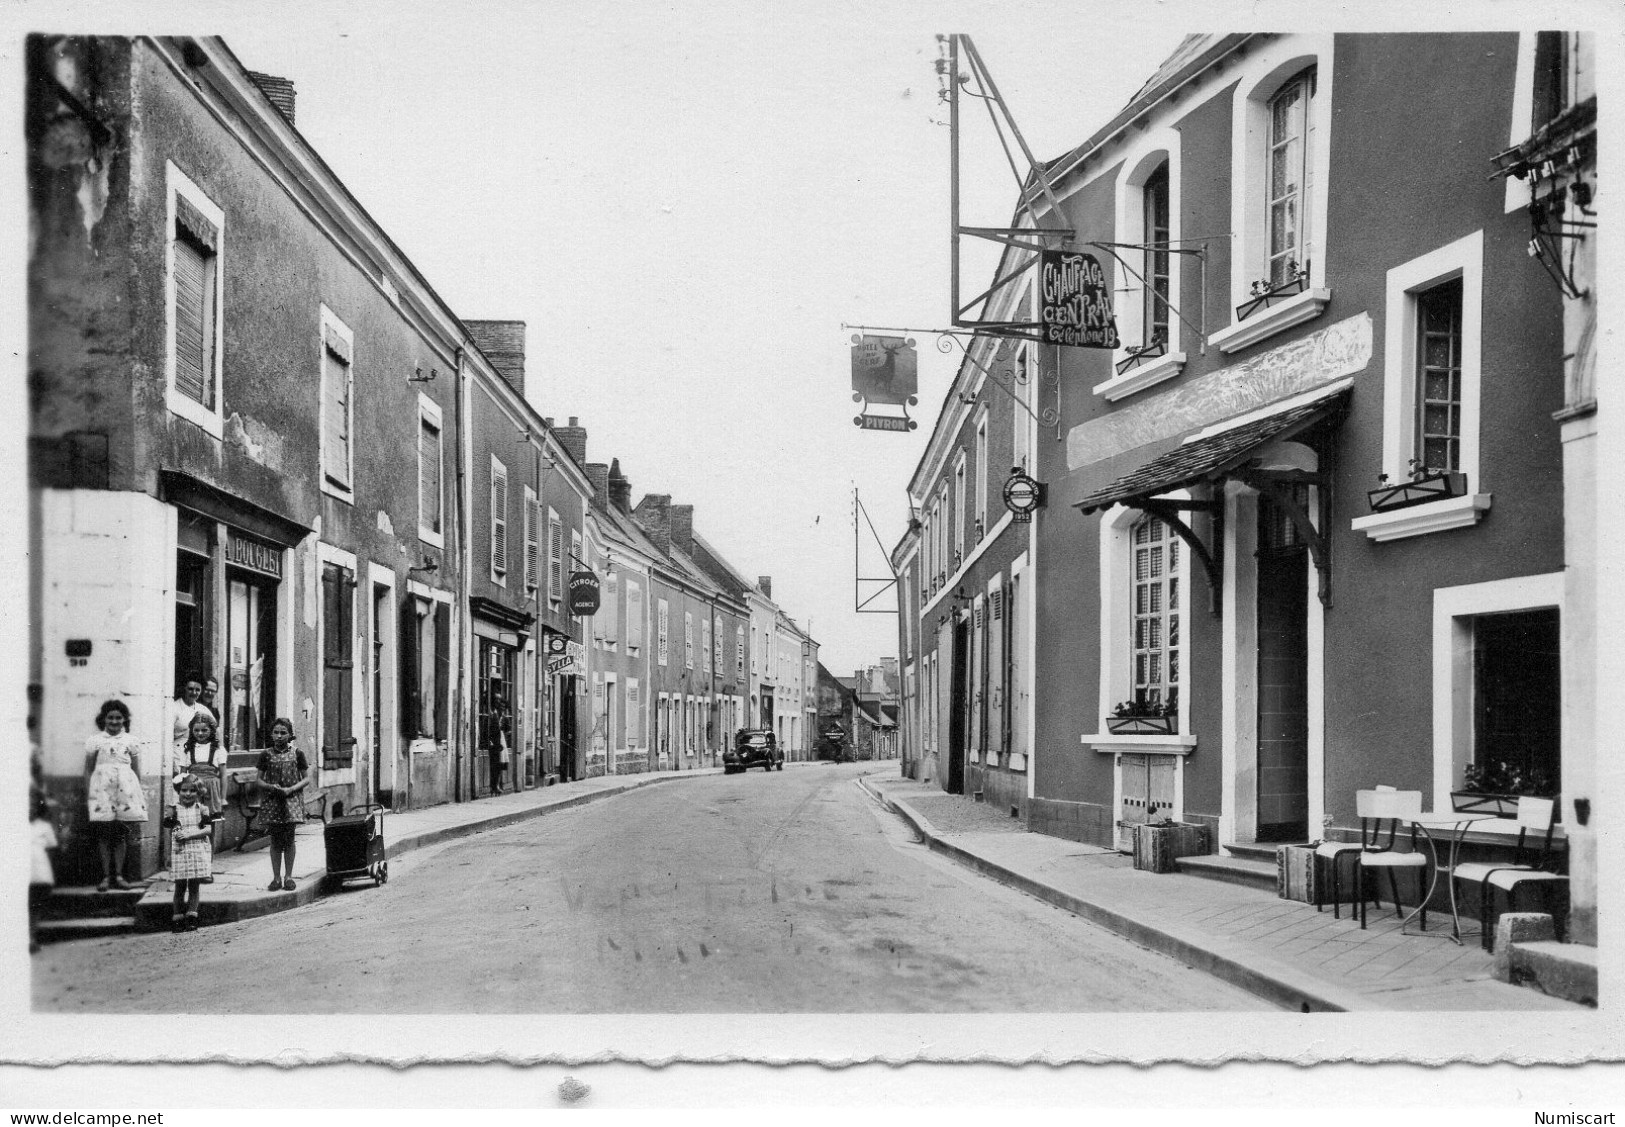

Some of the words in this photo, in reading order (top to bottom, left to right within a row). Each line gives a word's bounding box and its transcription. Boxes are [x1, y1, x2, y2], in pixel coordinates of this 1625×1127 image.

[1043, 255, 1104, 305] CHAUFFAGE
[1043, 290, 1112, 329] CENTRAL
[1103, 327, 1116, 347] 19
